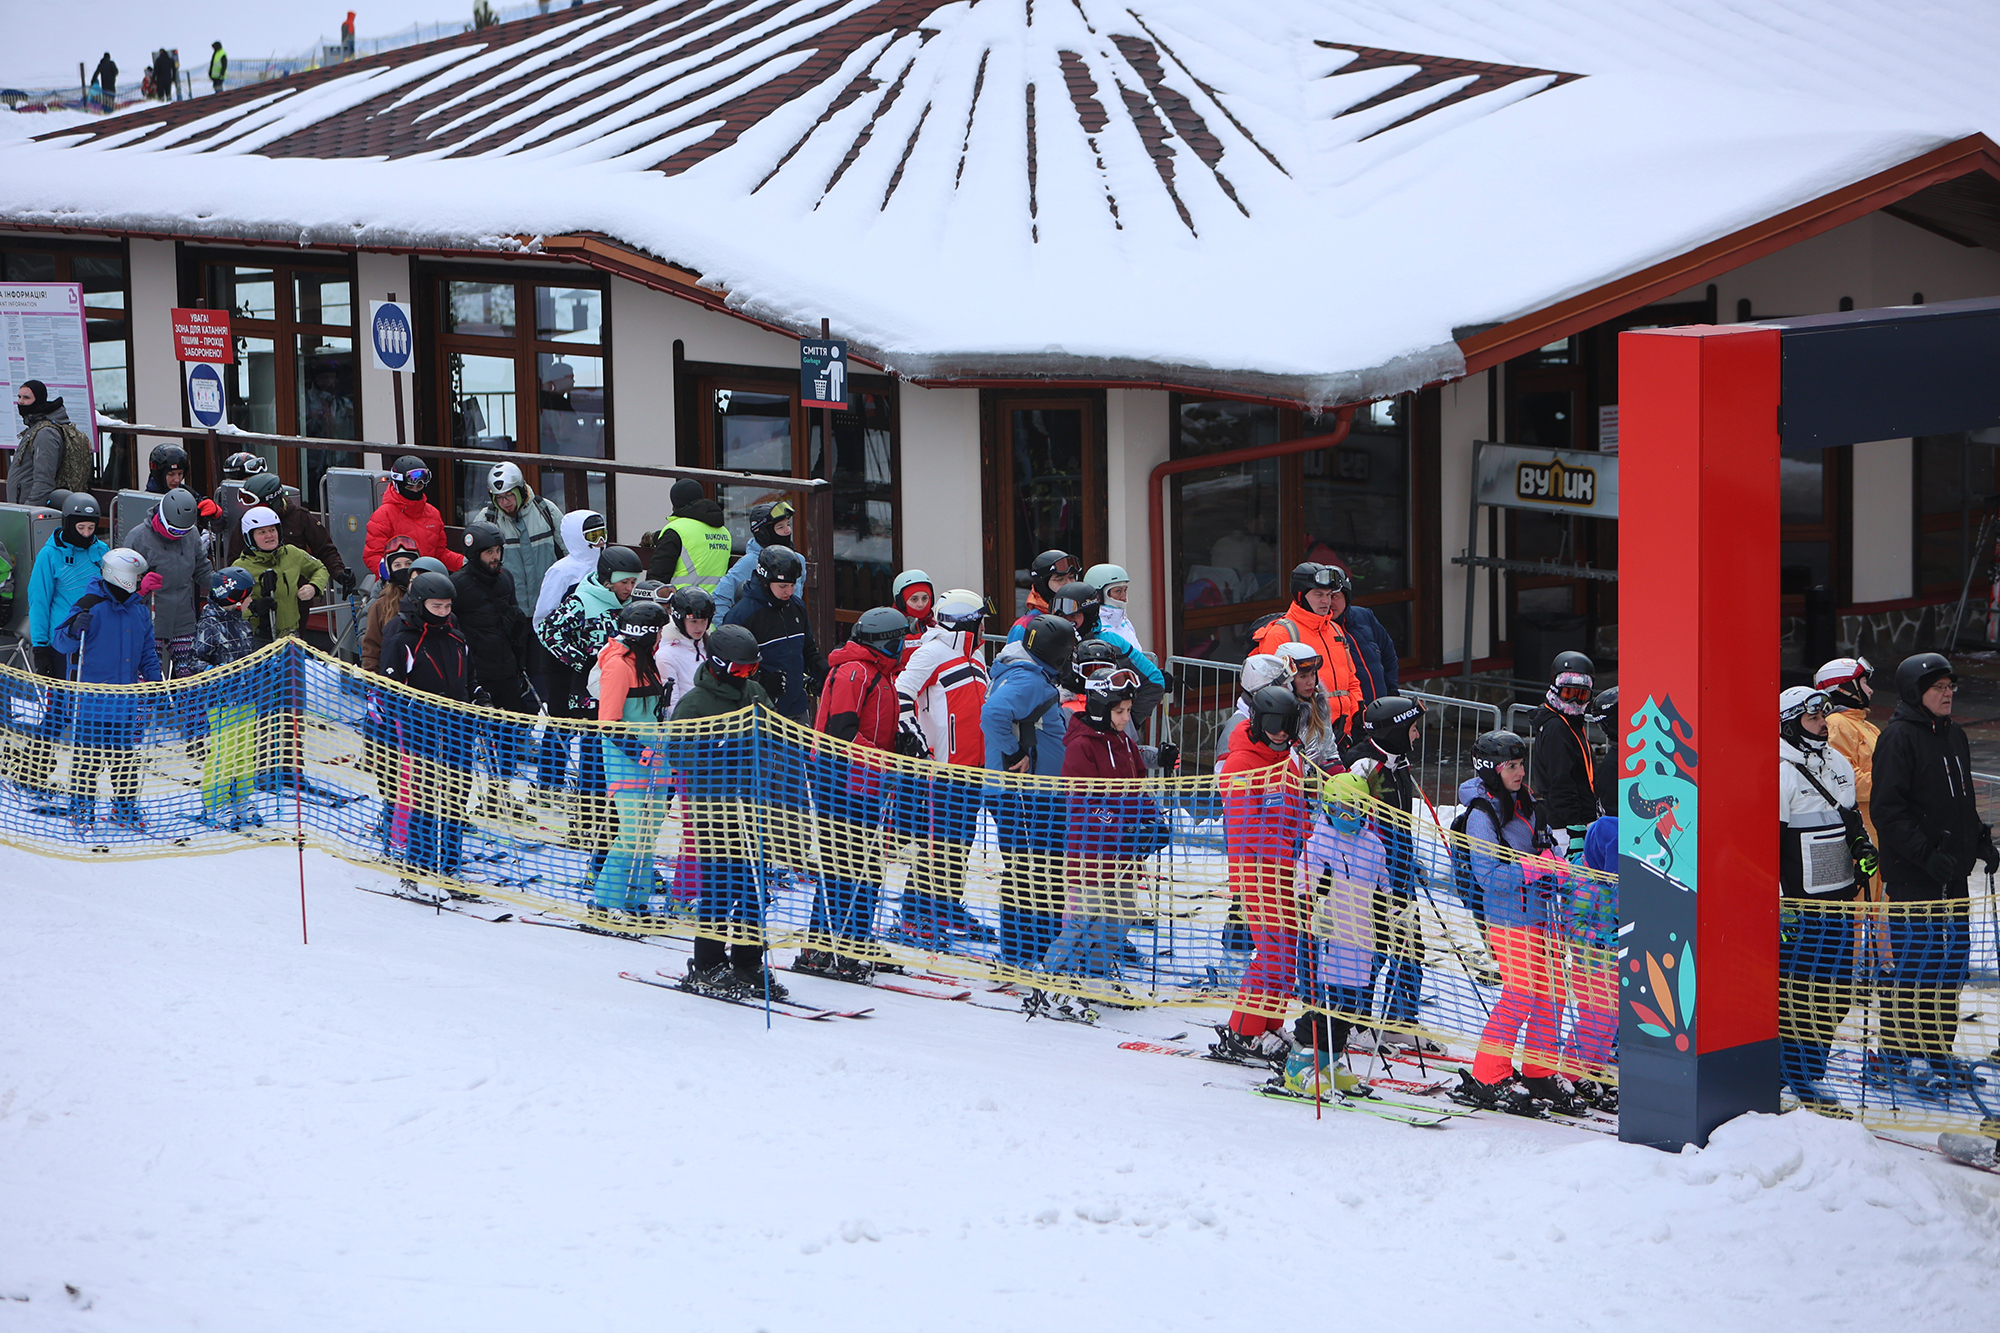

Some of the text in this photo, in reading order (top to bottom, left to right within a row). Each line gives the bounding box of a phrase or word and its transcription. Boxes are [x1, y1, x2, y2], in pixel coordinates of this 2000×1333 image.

[190, 314, 209, 322] УВАГА!
[175, 324, 189, 333] ЗОНА
[190, 325, 201, 335] ДЛЯ
[204, 337, 224, 348] ПРОХІД
[184, 348, 222, 357] ЗАБОРОНЕНО!
[803, 346, 827, 356] СМІТТЯ
[803, 356, 821, 366] Garbage
[704, 533, 730, 542] BUKOVEL
[708, 543, 729, 551] PATROL
[880, 628, 907, 640] uvex
[1392, 706, 1420, 724] uvex
